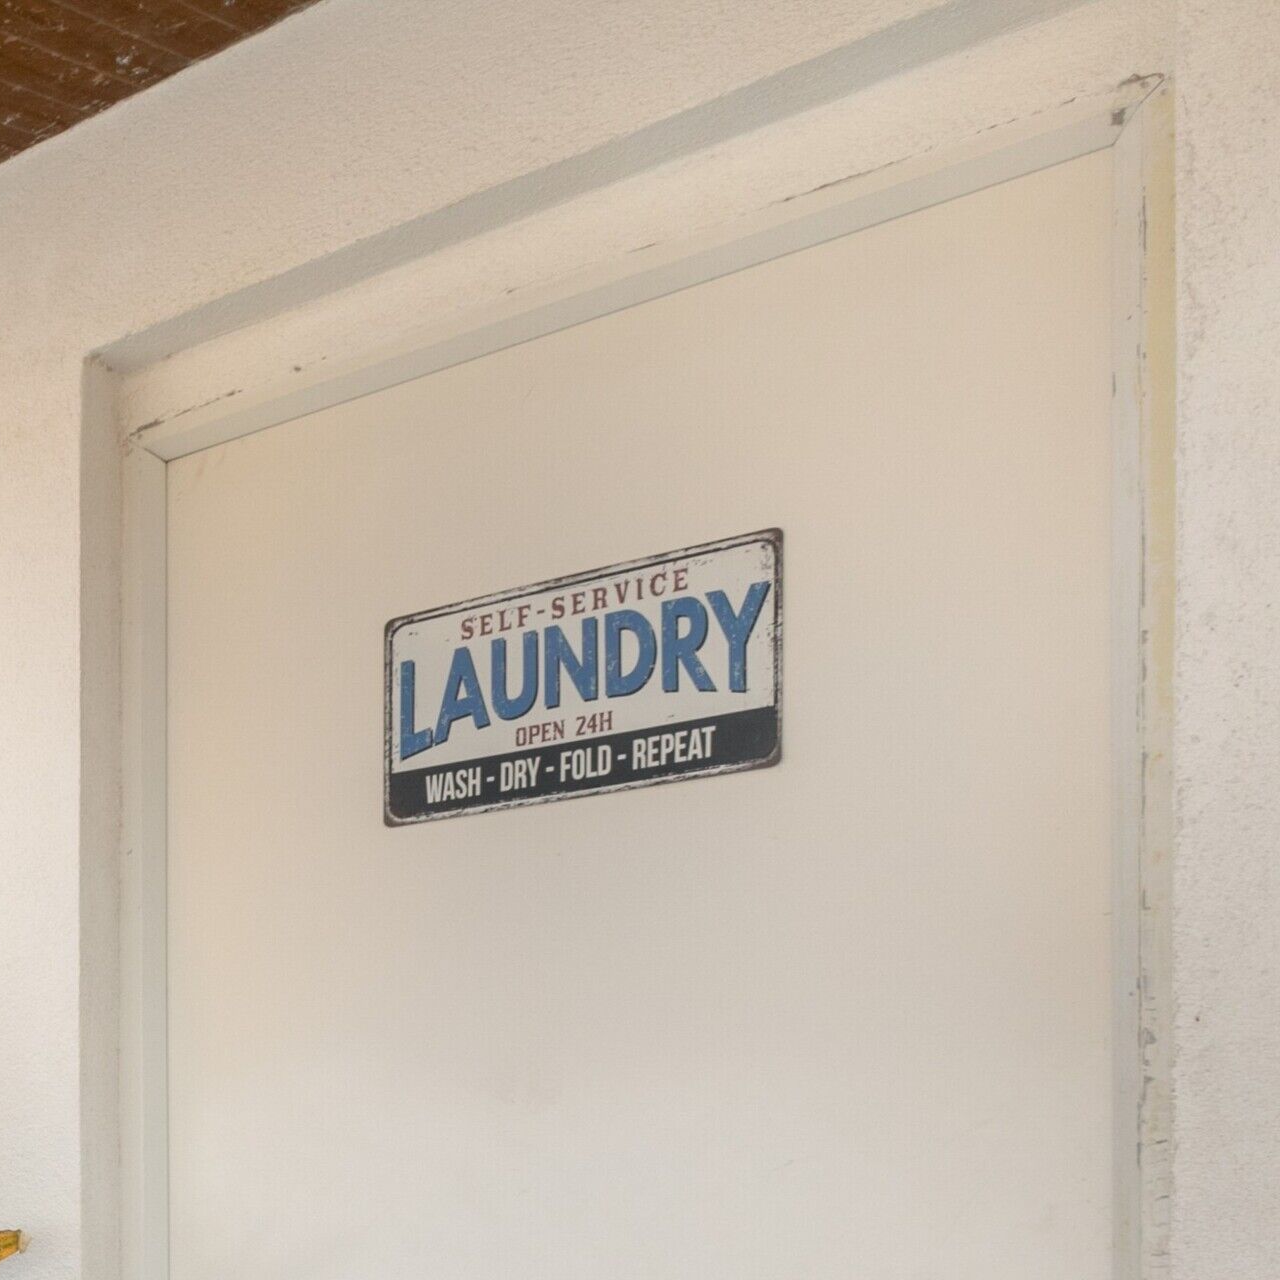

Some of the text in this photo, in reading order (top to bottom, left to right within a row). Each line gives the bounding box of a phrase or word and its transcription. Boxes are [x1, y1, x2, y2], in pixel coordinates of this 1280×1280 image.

[460, 567, 690, 641] SELF-SERVICE
[399, 580, 772, 762] LAUNDRY
[425, 771, 482, 804] WASH
[499, 756, 542, 793] DRY
[559, 745, 613, 783] FOLD
[632, 725, 717, 771] REPEAT
[515, 711, 614, 747] OPEN 24H
